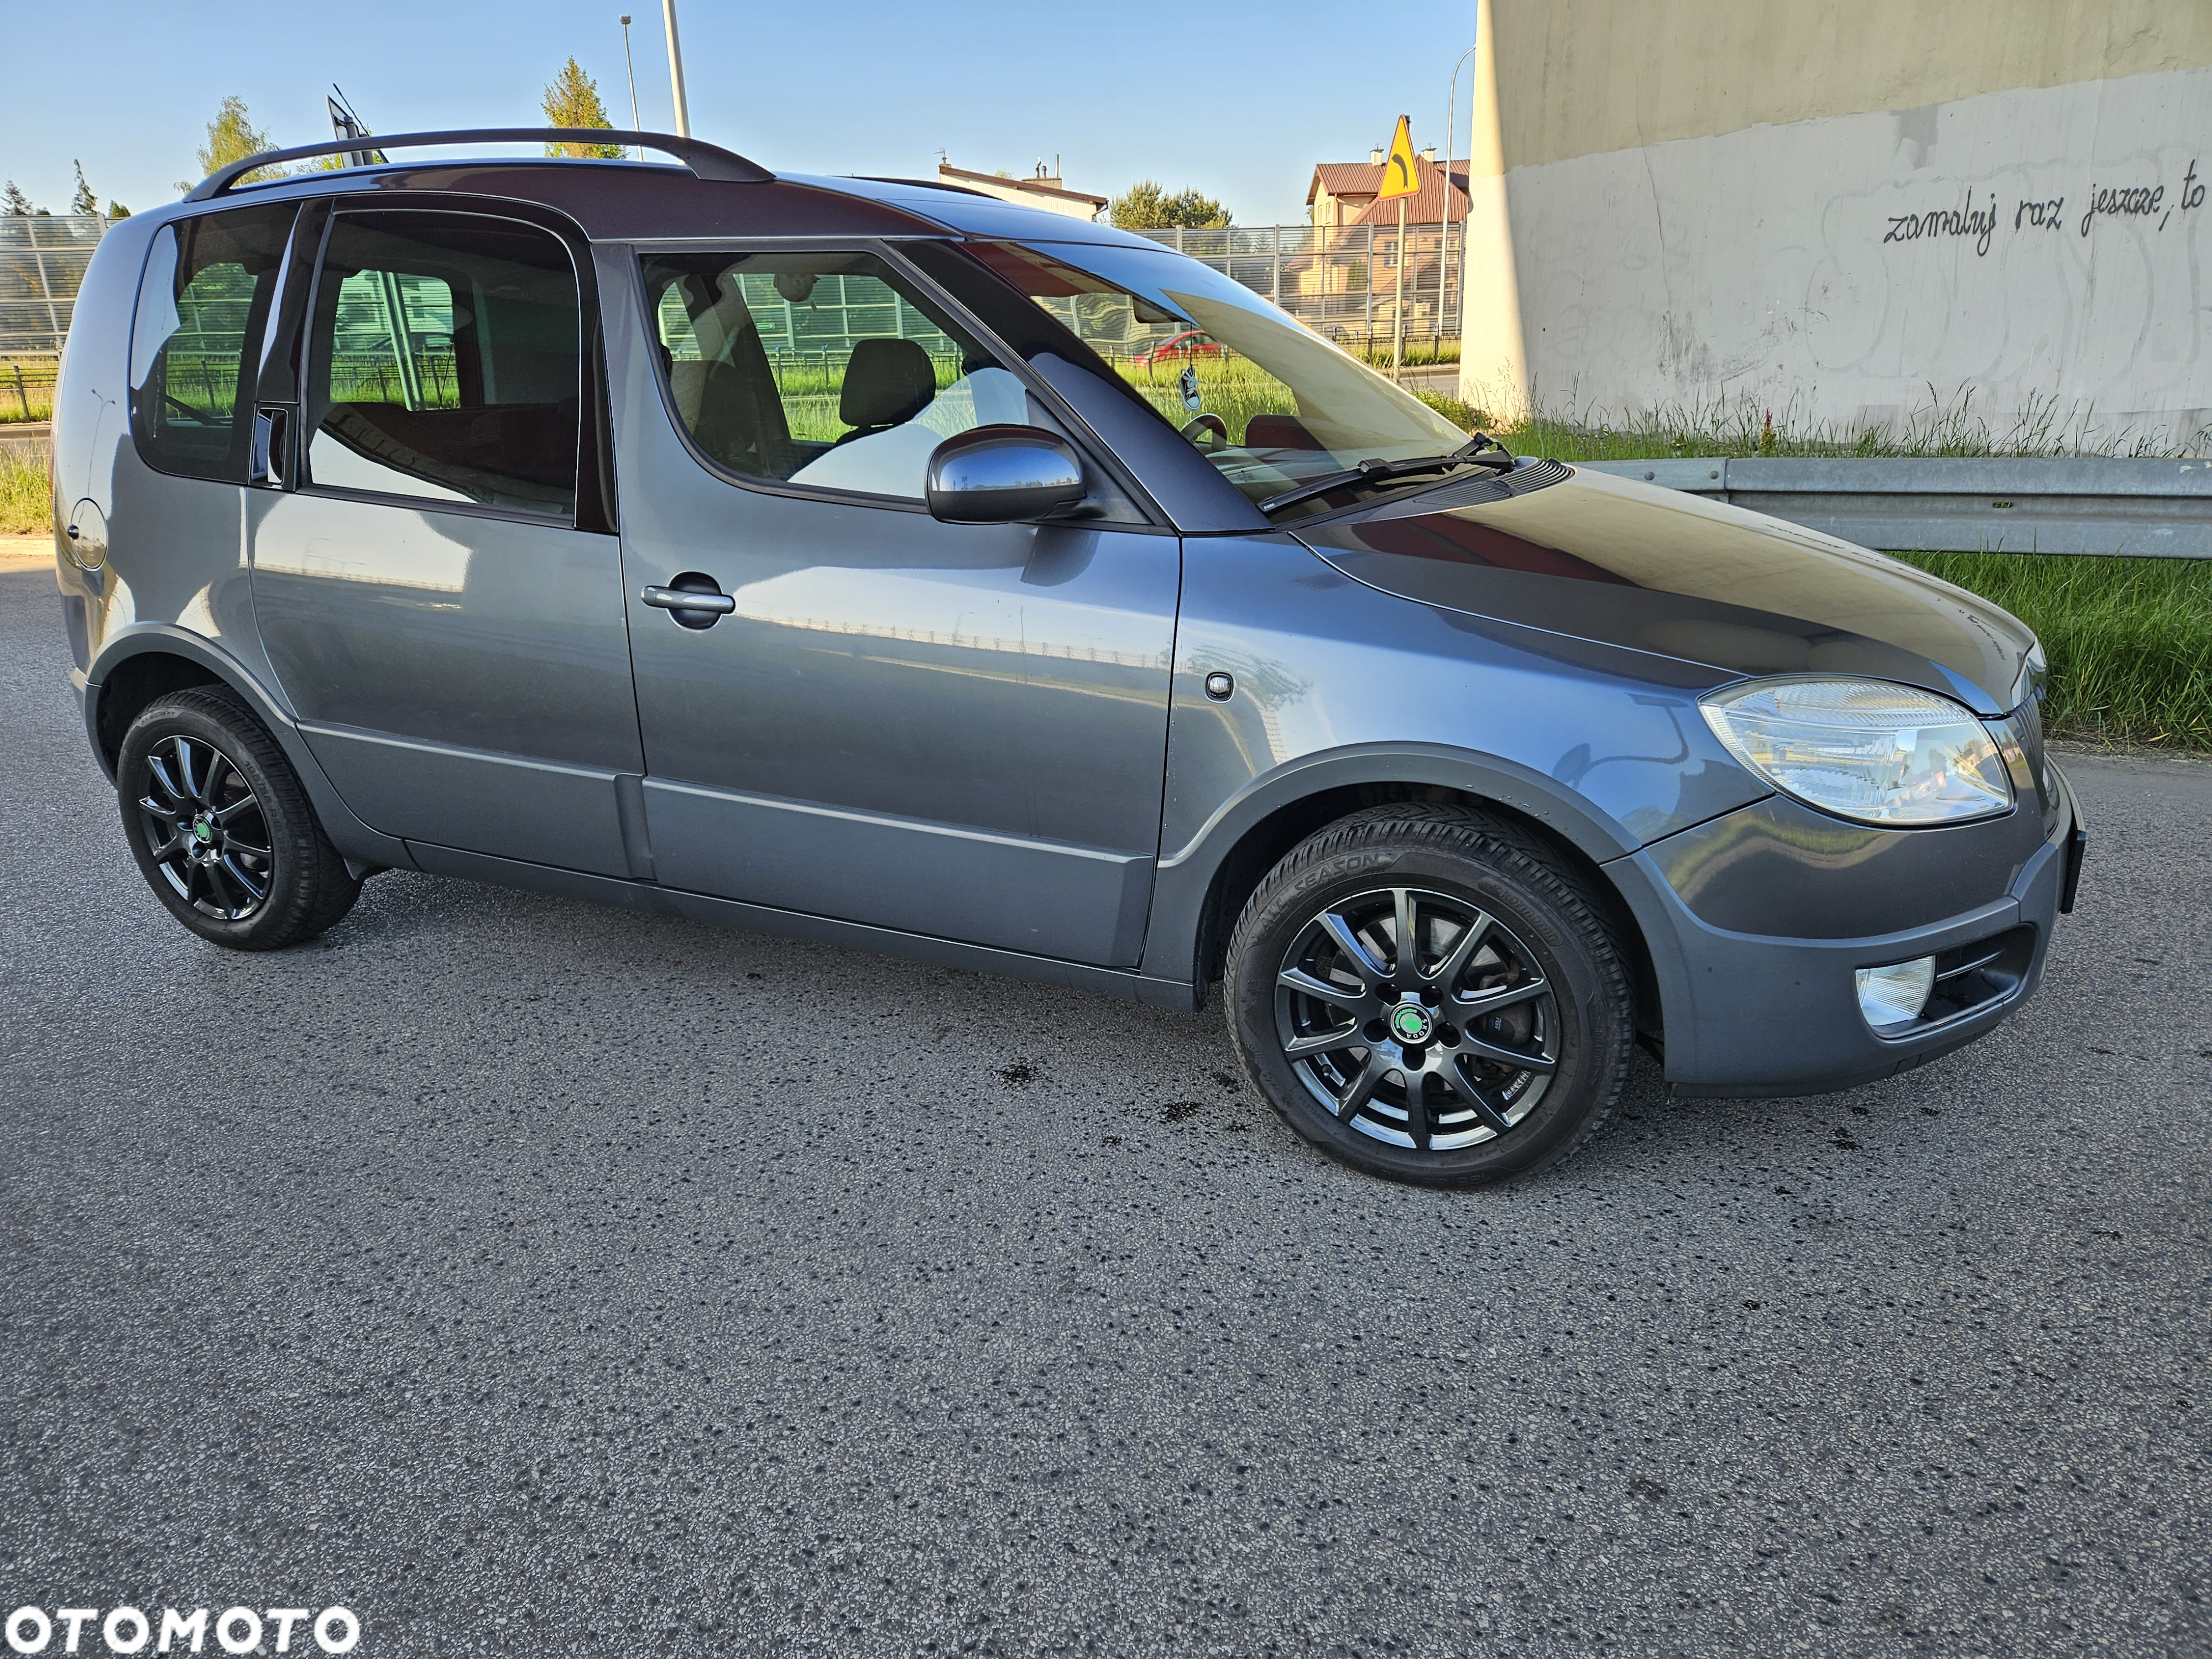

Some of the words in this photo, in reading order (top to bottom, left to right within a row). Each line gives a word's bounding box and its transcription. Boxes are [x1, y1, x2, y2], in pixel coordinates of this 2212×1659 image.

[1884, 186, 1996, 257] zamaluj
[2015, 197, 2064, 230] raz
[2081, 184, 2174, 237] jeszcze,
[2181, 159, 2205, 210] to
[1293, 852, 1380, 898] SEASON
